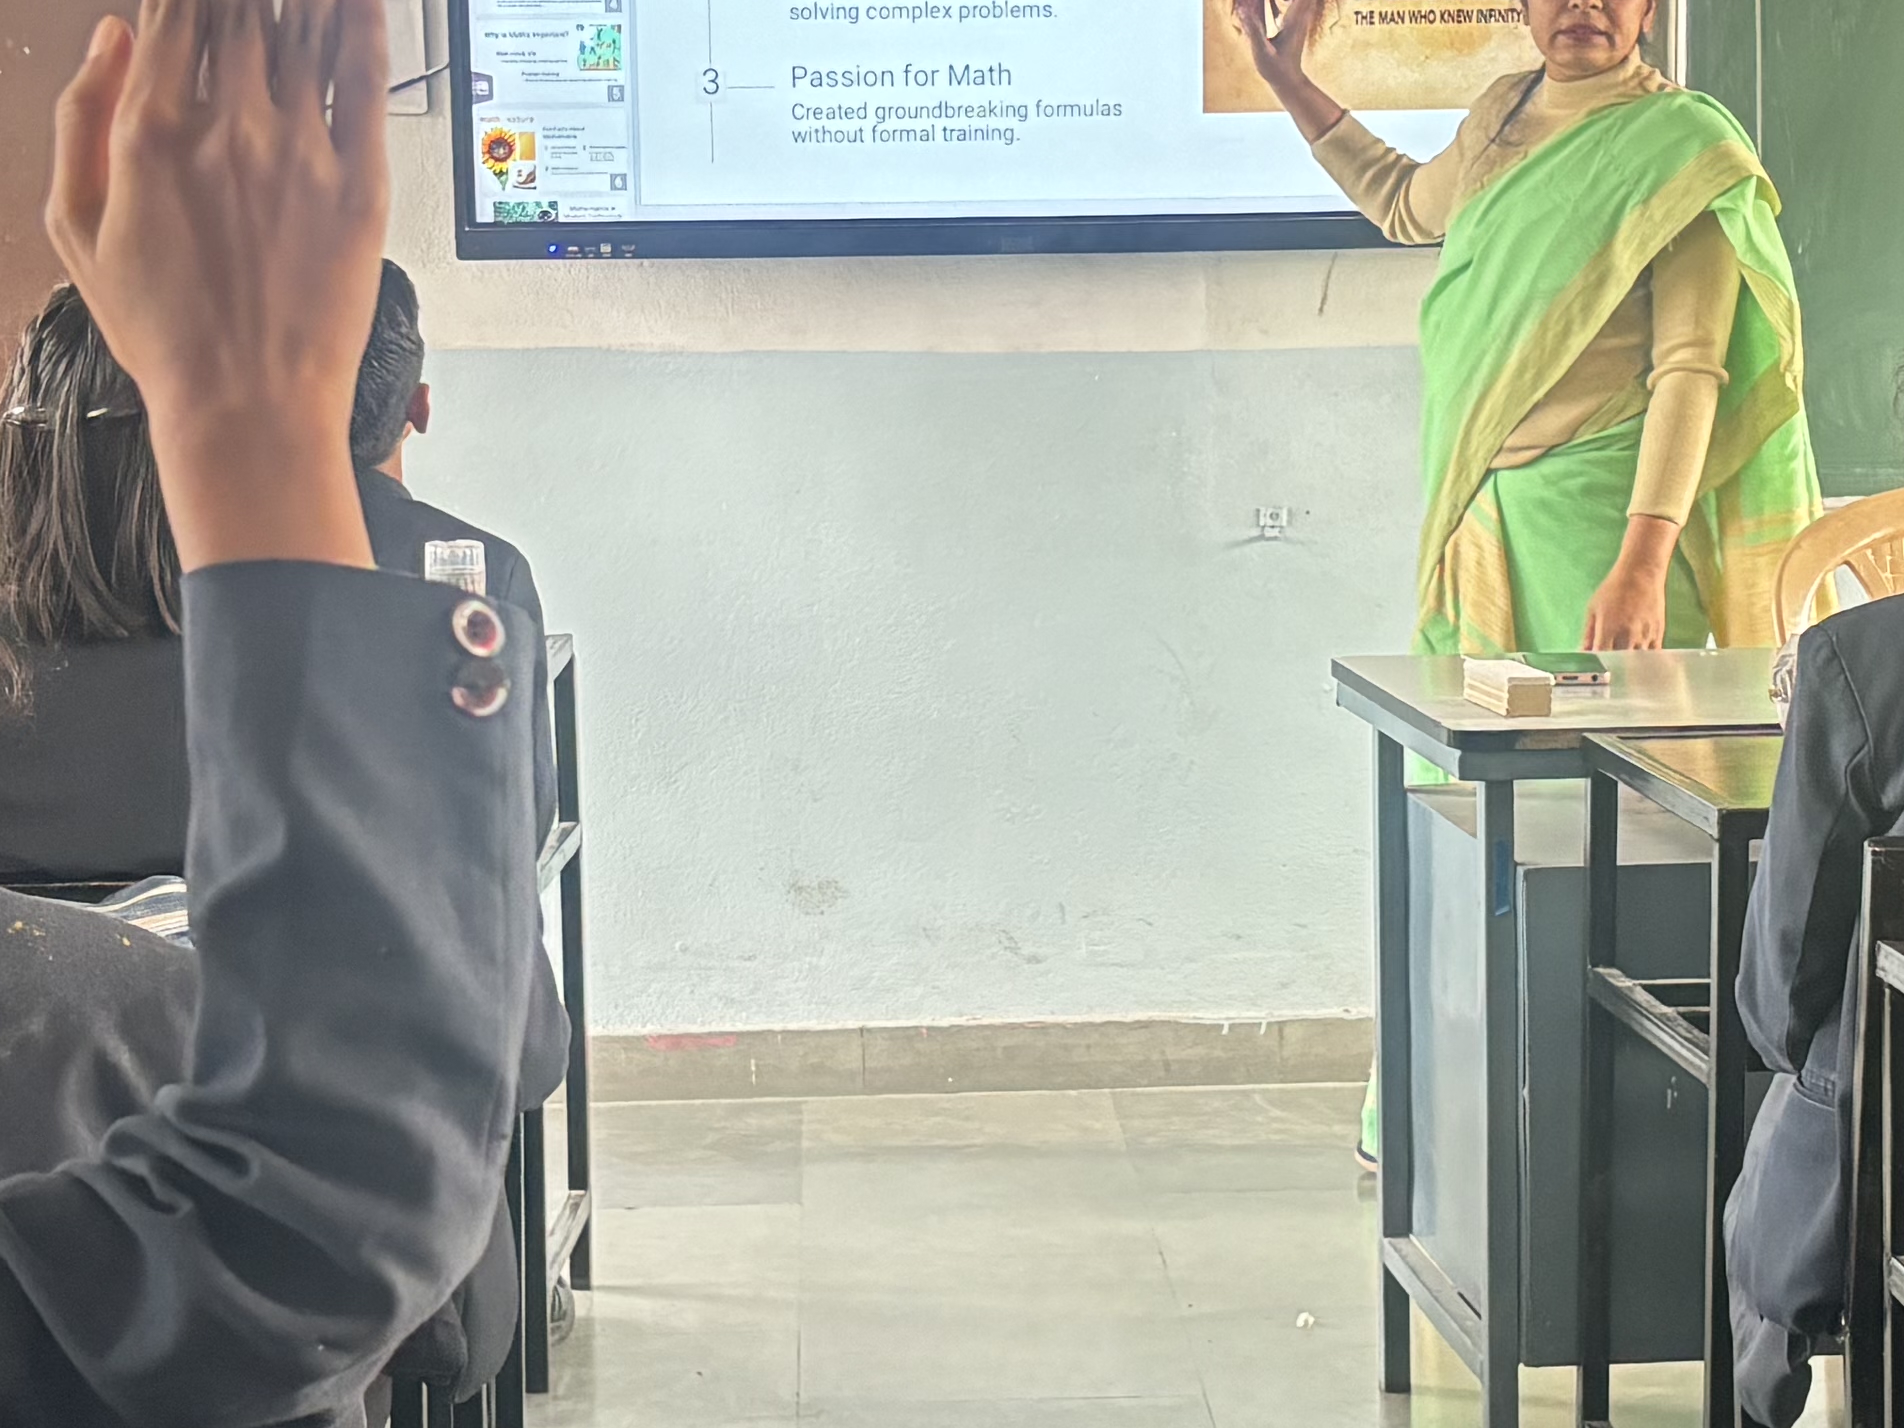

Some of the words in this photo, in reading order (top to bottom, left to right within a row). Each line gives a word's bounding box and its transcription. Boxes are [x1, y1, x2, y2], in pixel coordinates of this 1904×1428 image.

[790, 2, 859, 24] solving
[866, 1, 952, 23] complex
[959, 0, 1057, 23] problems.
[1354, 10, 1375, 26] THE
[1378, 10, 1405, 25] MAN
[1408, 9, 1436, 24] WHO
[1439, 8, 1472, 23] KNEW
[1476, 8, 1524, 23] INFINITY
[702, 68, 720, 95] 3
[792, 65, 894, 88] Passion
[904, 64, 939, 86] for
[949, 63, 1011, 86] Math
[792, 102, 867, 120] Created
[874, 100, 1027, 127] groundbreaking
[1036, 99, 1122, 117] formulas
[792, 126, 864, 143] without
[872, 121, 935, 143] formal
[943, 121, 1023, 145] training.
